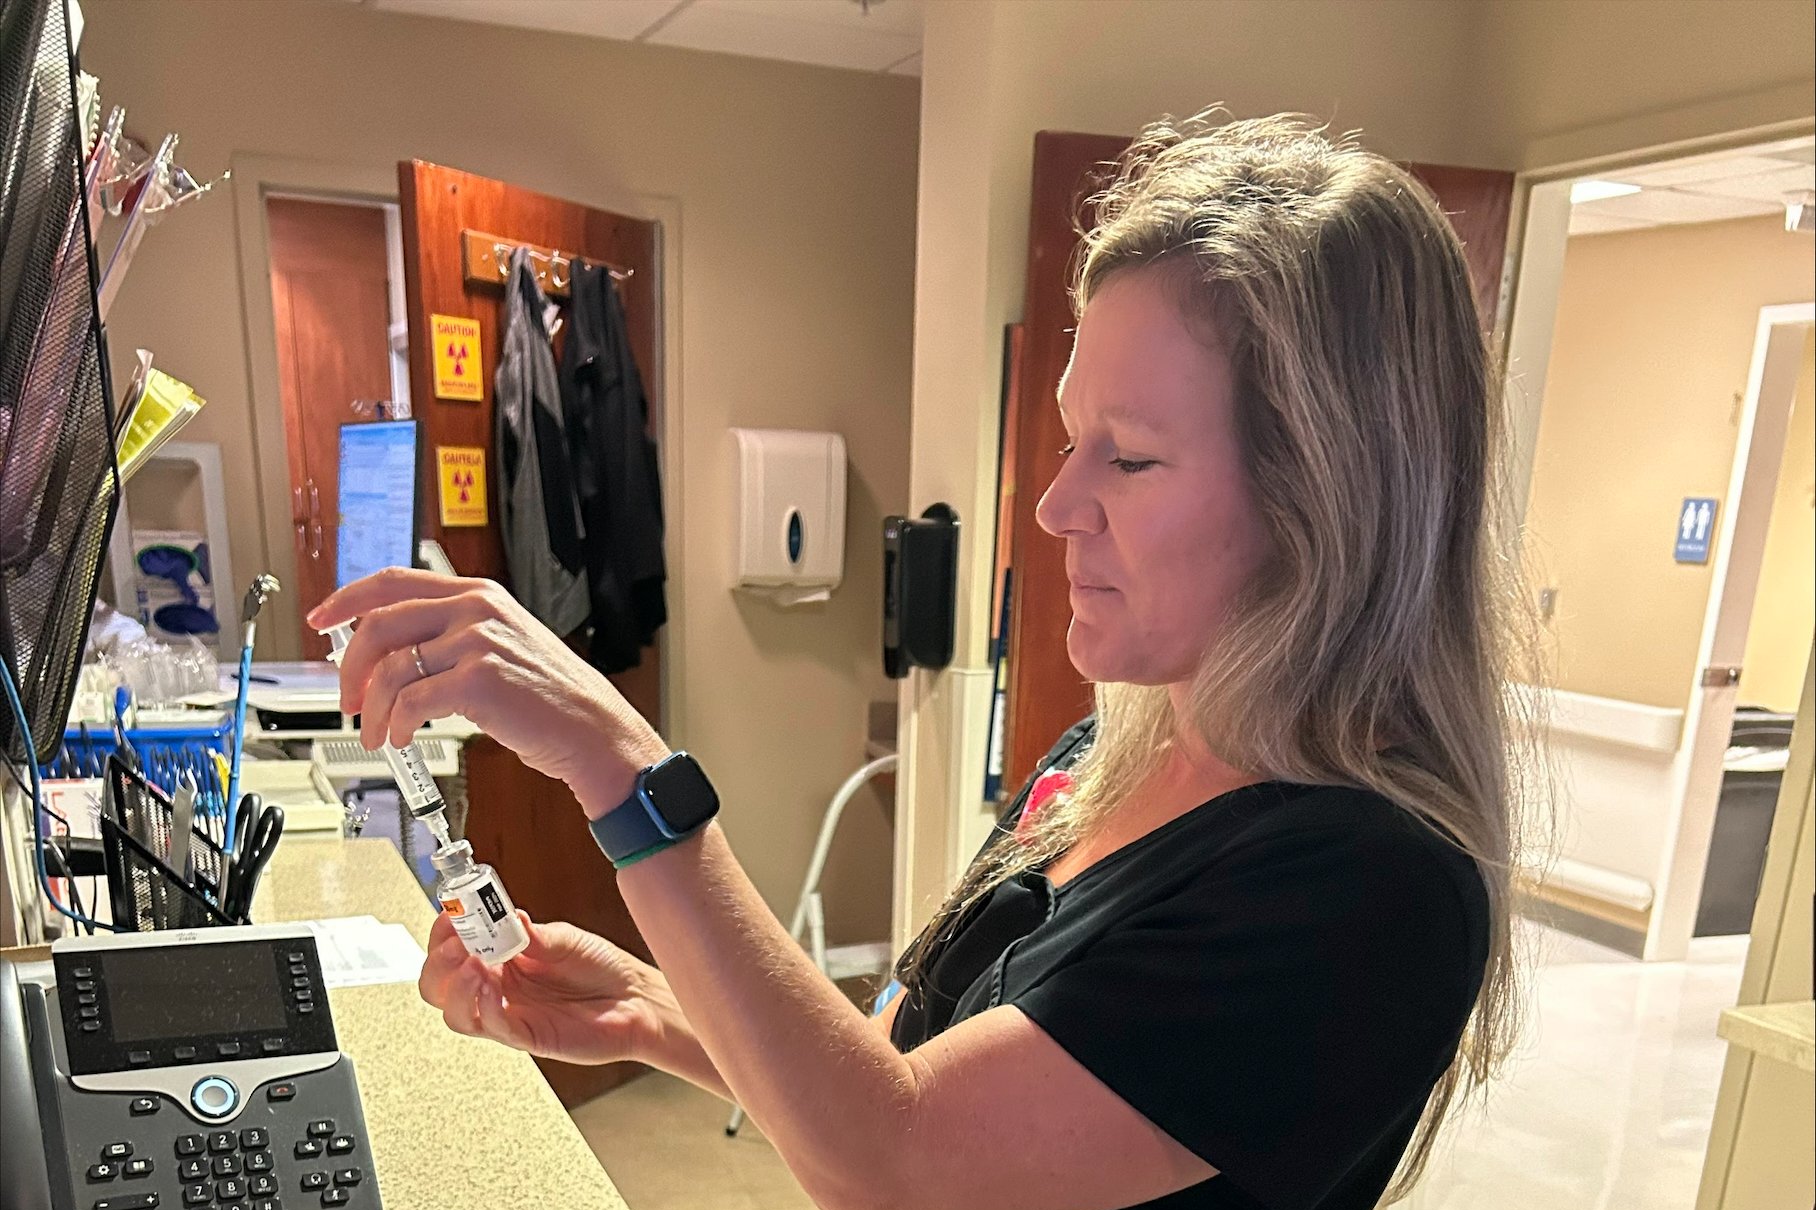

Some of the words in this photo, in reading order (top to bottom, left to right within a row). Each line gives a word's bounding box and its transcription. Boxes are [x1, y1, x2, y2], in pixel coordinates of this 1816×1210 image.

[400, 750, 408, 758] 5
[406, 762, 412, 770] 4
[412, 772, 419, 780] 3
[219, 1135, 227, 1144] 2
[251, 1131, 259, 1140] 3
[187, 1138, 193, 1147] 1
[223, 1158, 231, 1168] 5
[255, 1154, 263, 1164] 6
[190, 1162, 198, 1171] 4
[227, 1182, 236, 1191] 8
[259, 1178, 268, 1188] 9
[195, 1186, 203, 1195] 7
